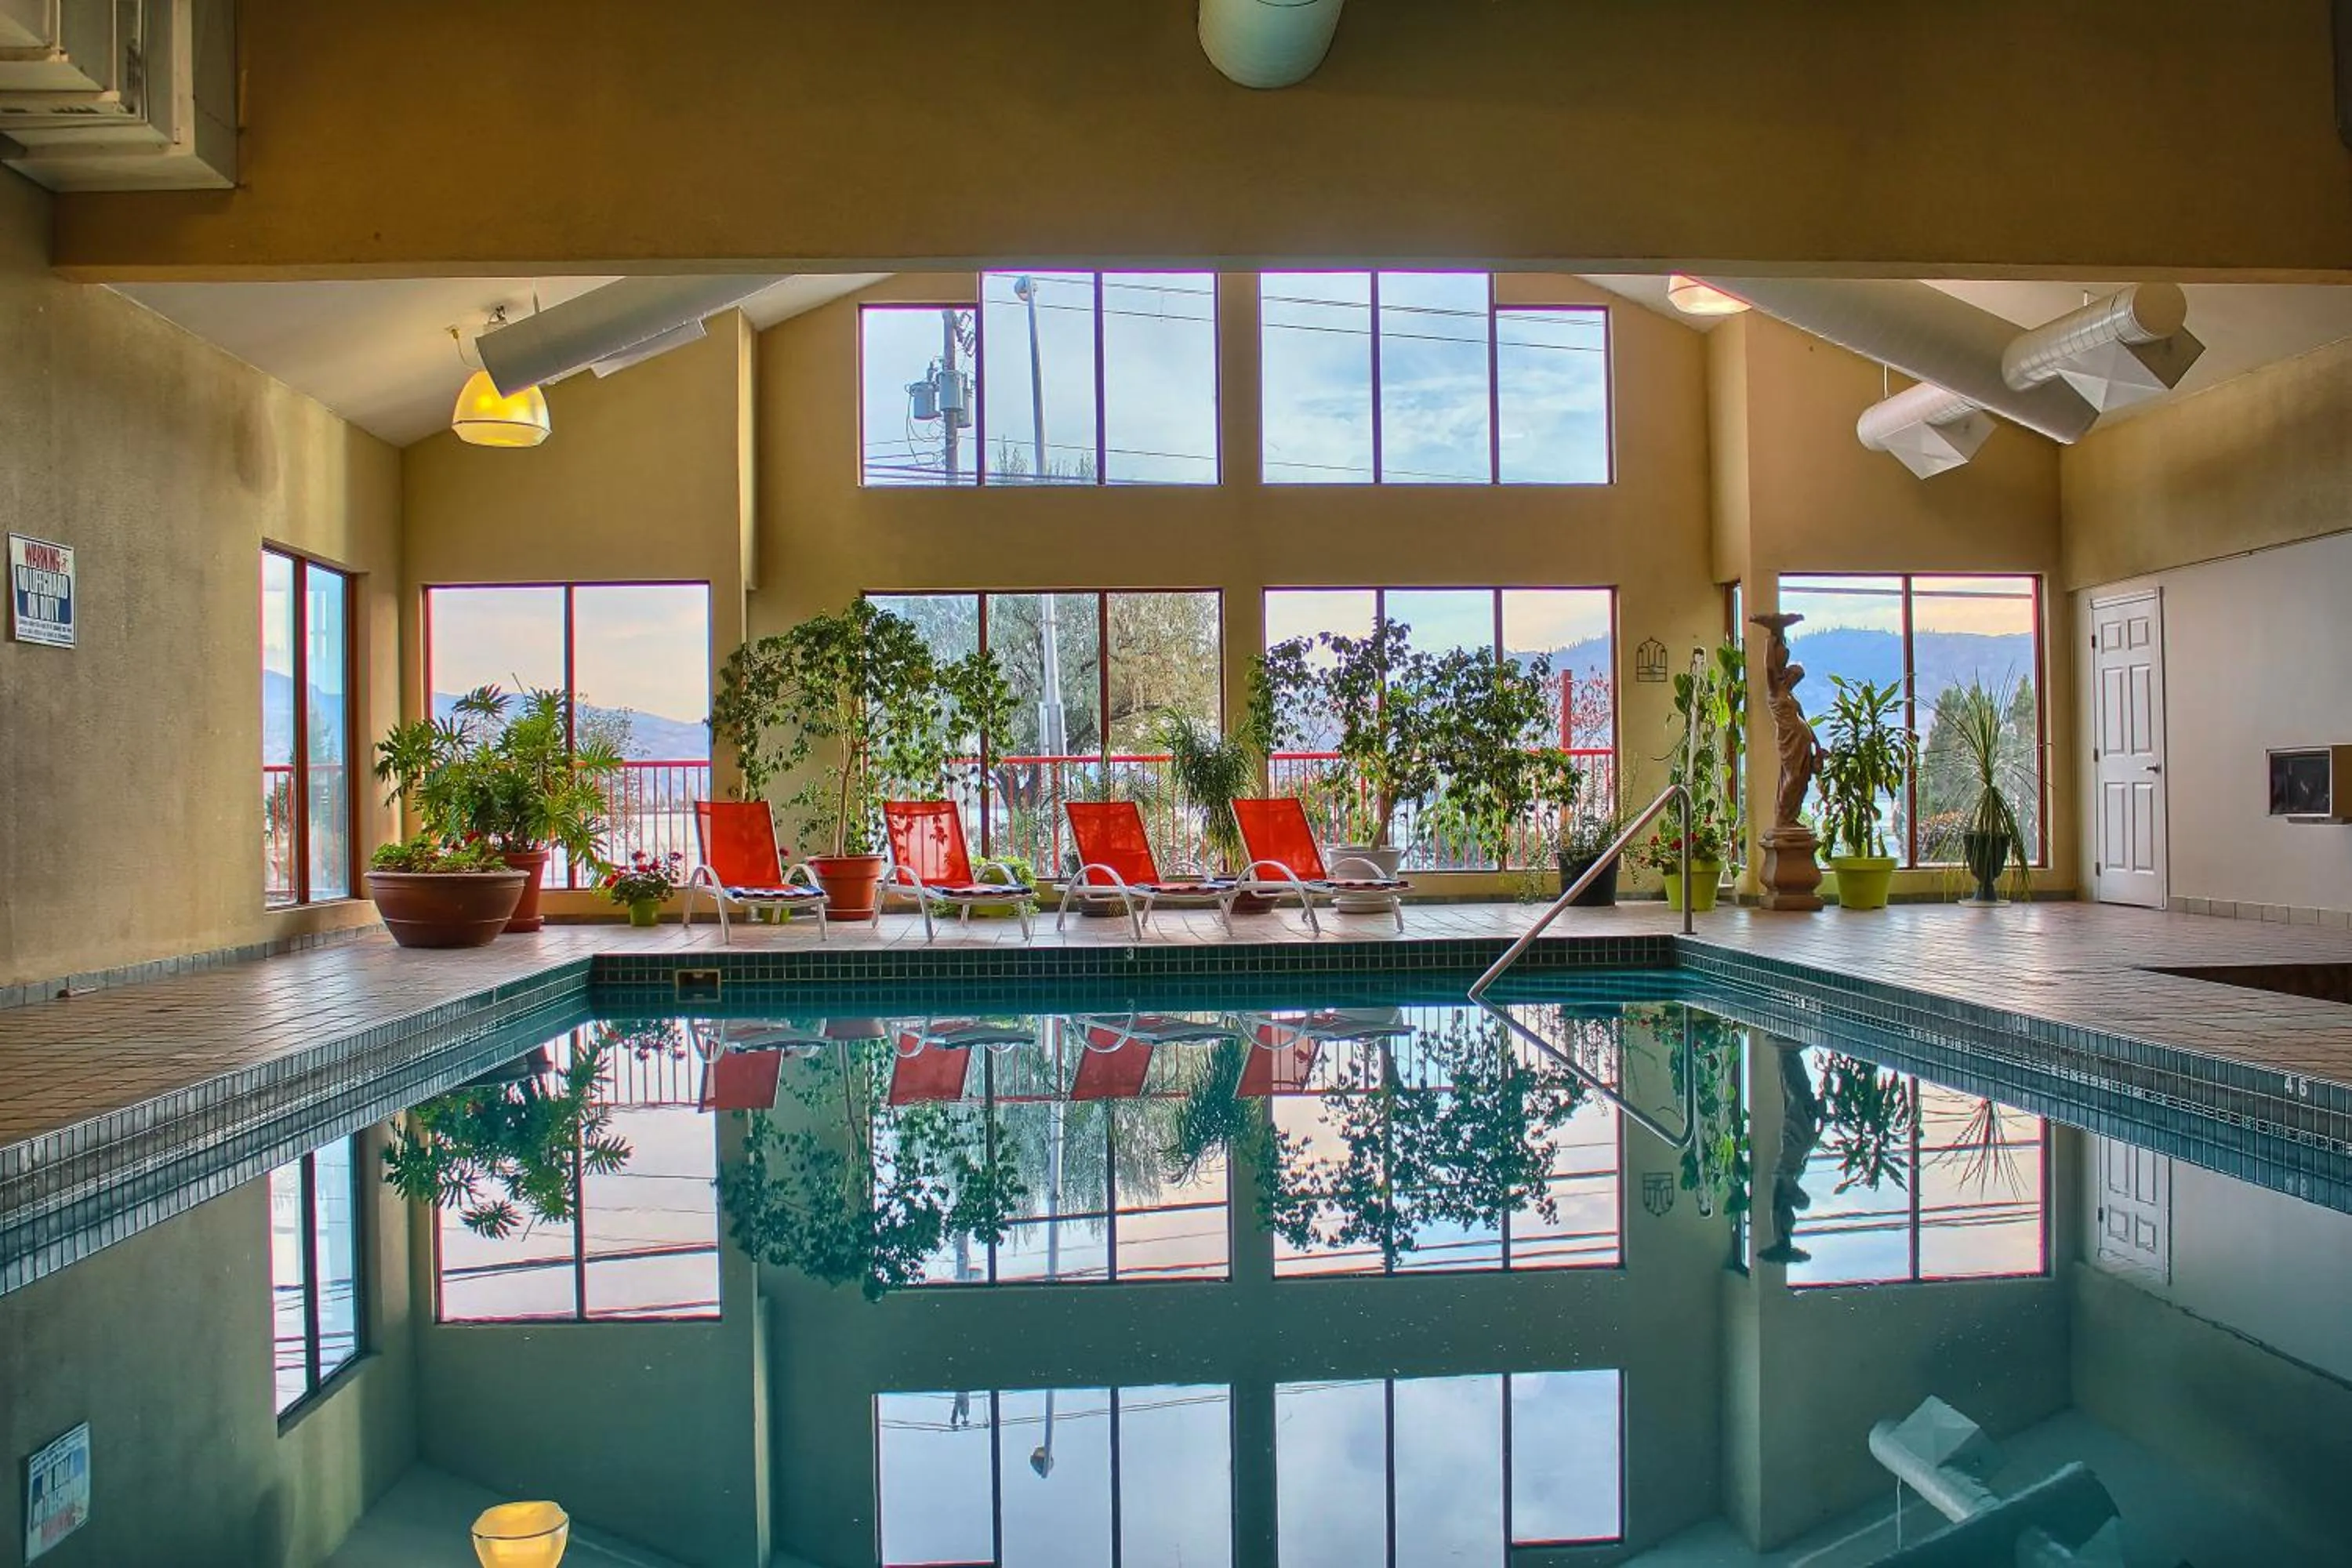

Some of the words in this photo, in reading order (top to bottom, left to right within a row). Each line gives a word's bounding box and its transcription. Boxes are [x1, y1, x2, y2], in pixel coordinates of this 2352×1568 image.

[24, 541, 60, 572] WARNING
[1127, 947, 1134, 960] 3
[2284, 1075, 2293, 1094] 4
[2298, 1077, 2307, 1097] 6
